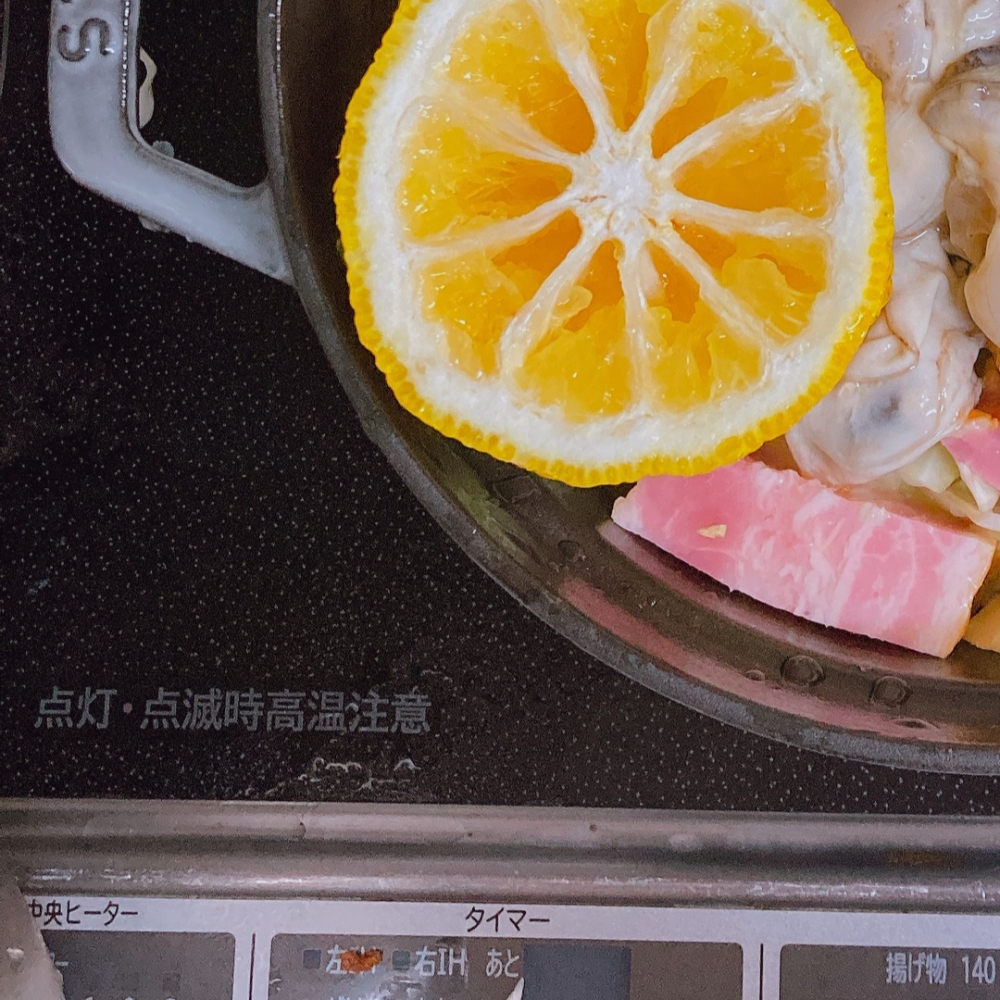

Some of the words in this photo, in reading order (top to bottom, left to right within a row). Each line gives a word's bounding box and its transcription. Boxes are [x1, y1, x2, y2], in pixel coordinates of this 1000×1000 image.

[35, 686, 432, 734] 点灯・点滅時高温注意
[465, 907, 550, 932] タイマー
[486, 948, 520, 978] あと
[886, 952, 947, 984] 揚げ物
[961, 955, 996, 984] 140
